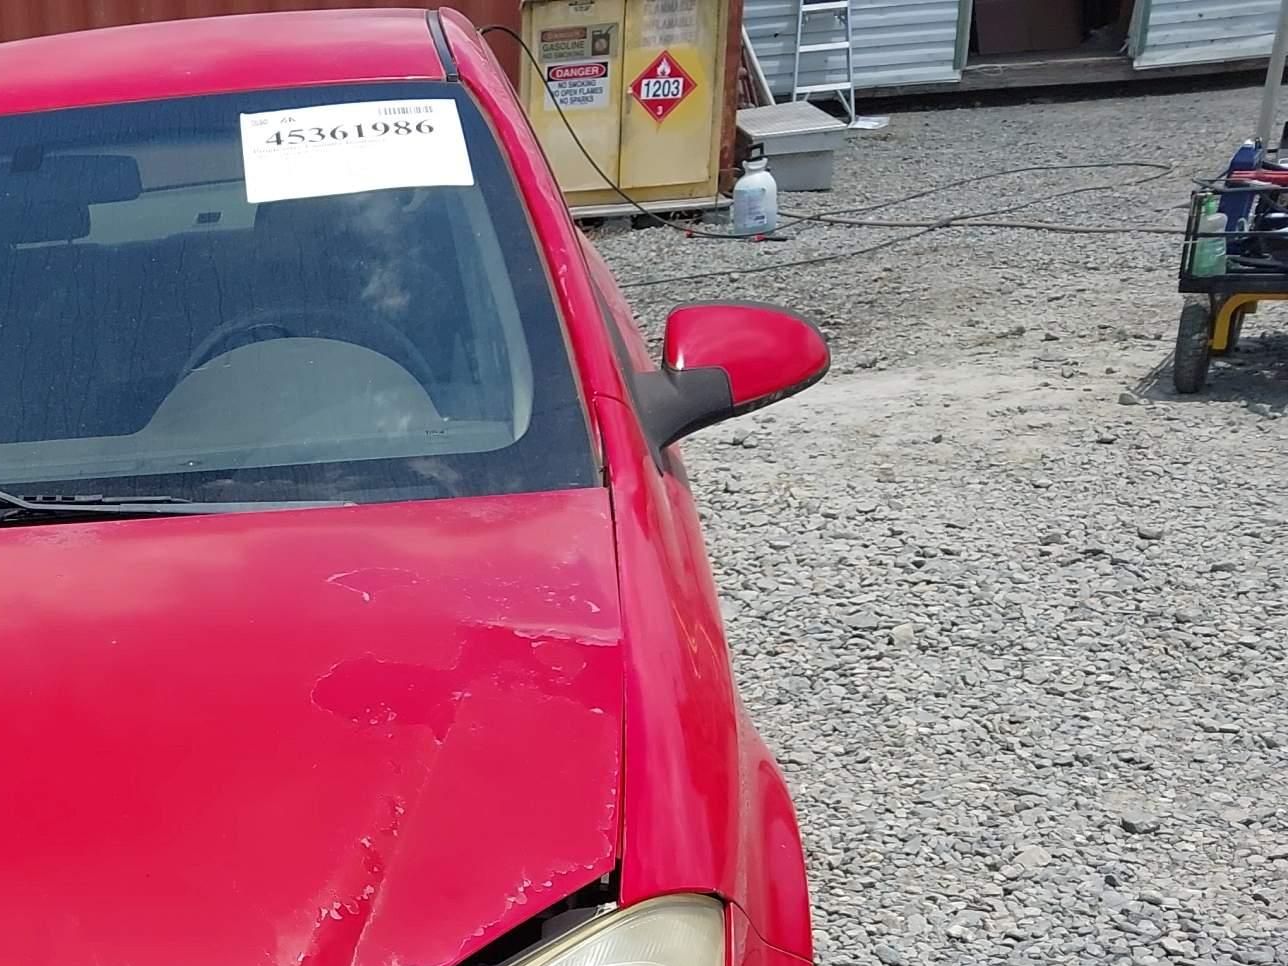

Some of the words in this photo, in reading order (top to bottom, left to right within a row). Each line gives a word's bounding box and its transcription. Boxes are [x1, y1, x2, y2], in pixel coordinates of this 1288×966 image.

[542, 41, 584, 52] GASOLINE
[555, 66, 600, 78] DANGER
[568, 80, 597, 88] SMOKING
[644, 80, 681, 98] 1203
[561, 88, 578, 96] OPEN
[579, 87, 604, 95] FLAMES
[570, 96, 594, 104] SPARKS
[656, 105, 663, 115] 3
[265, 119, 434, 146] 45361986
